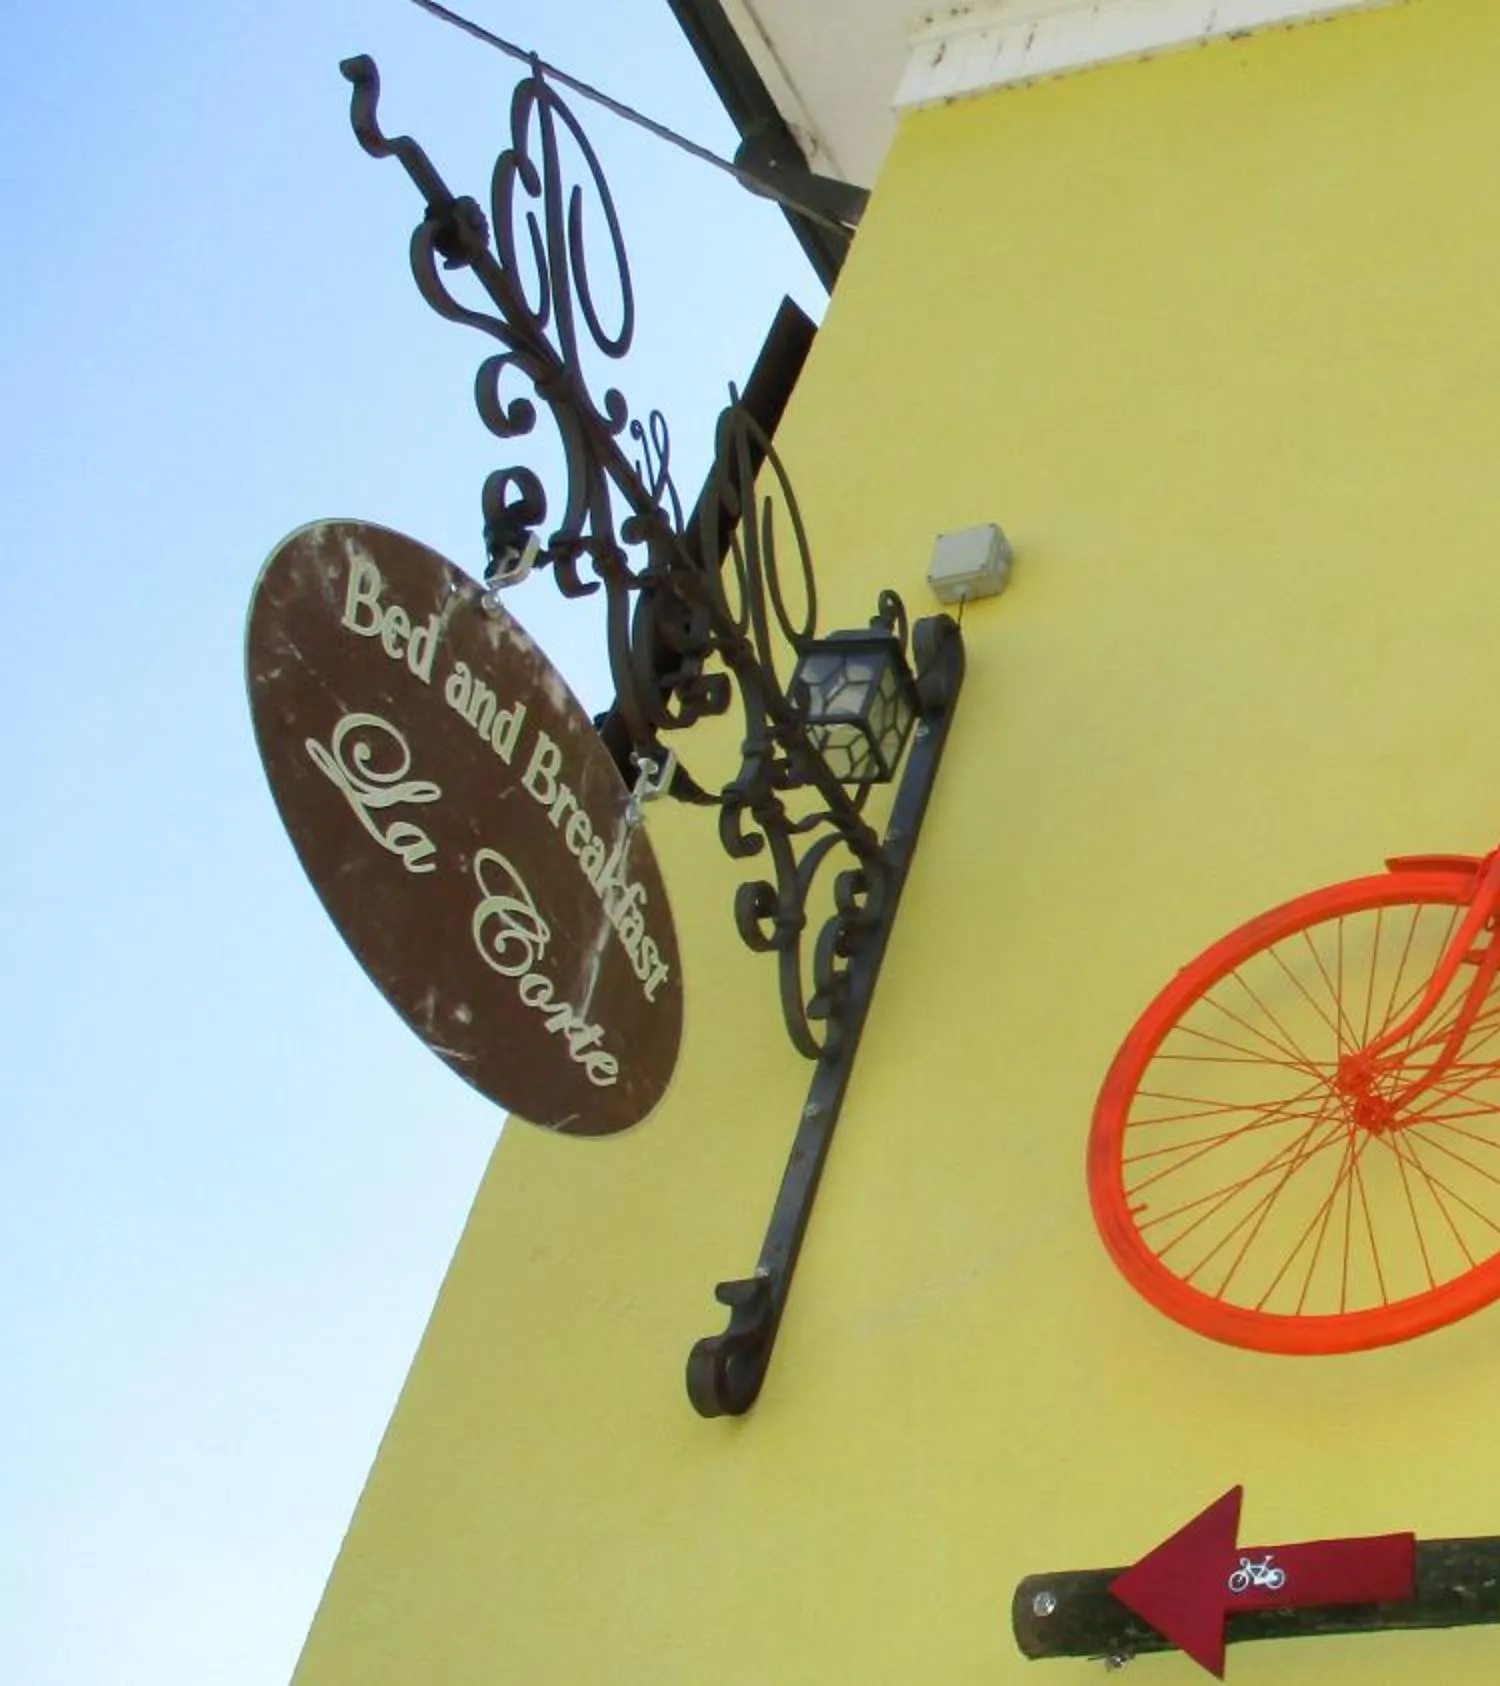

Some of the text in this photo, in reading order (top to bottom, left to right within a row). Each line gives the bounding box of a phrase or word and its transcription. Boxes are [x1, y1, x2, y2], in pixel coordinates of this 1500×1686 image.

[305, 713, 618, 1086] La Corte
[341, 553, 669, 1002] Bed and Breakfast
